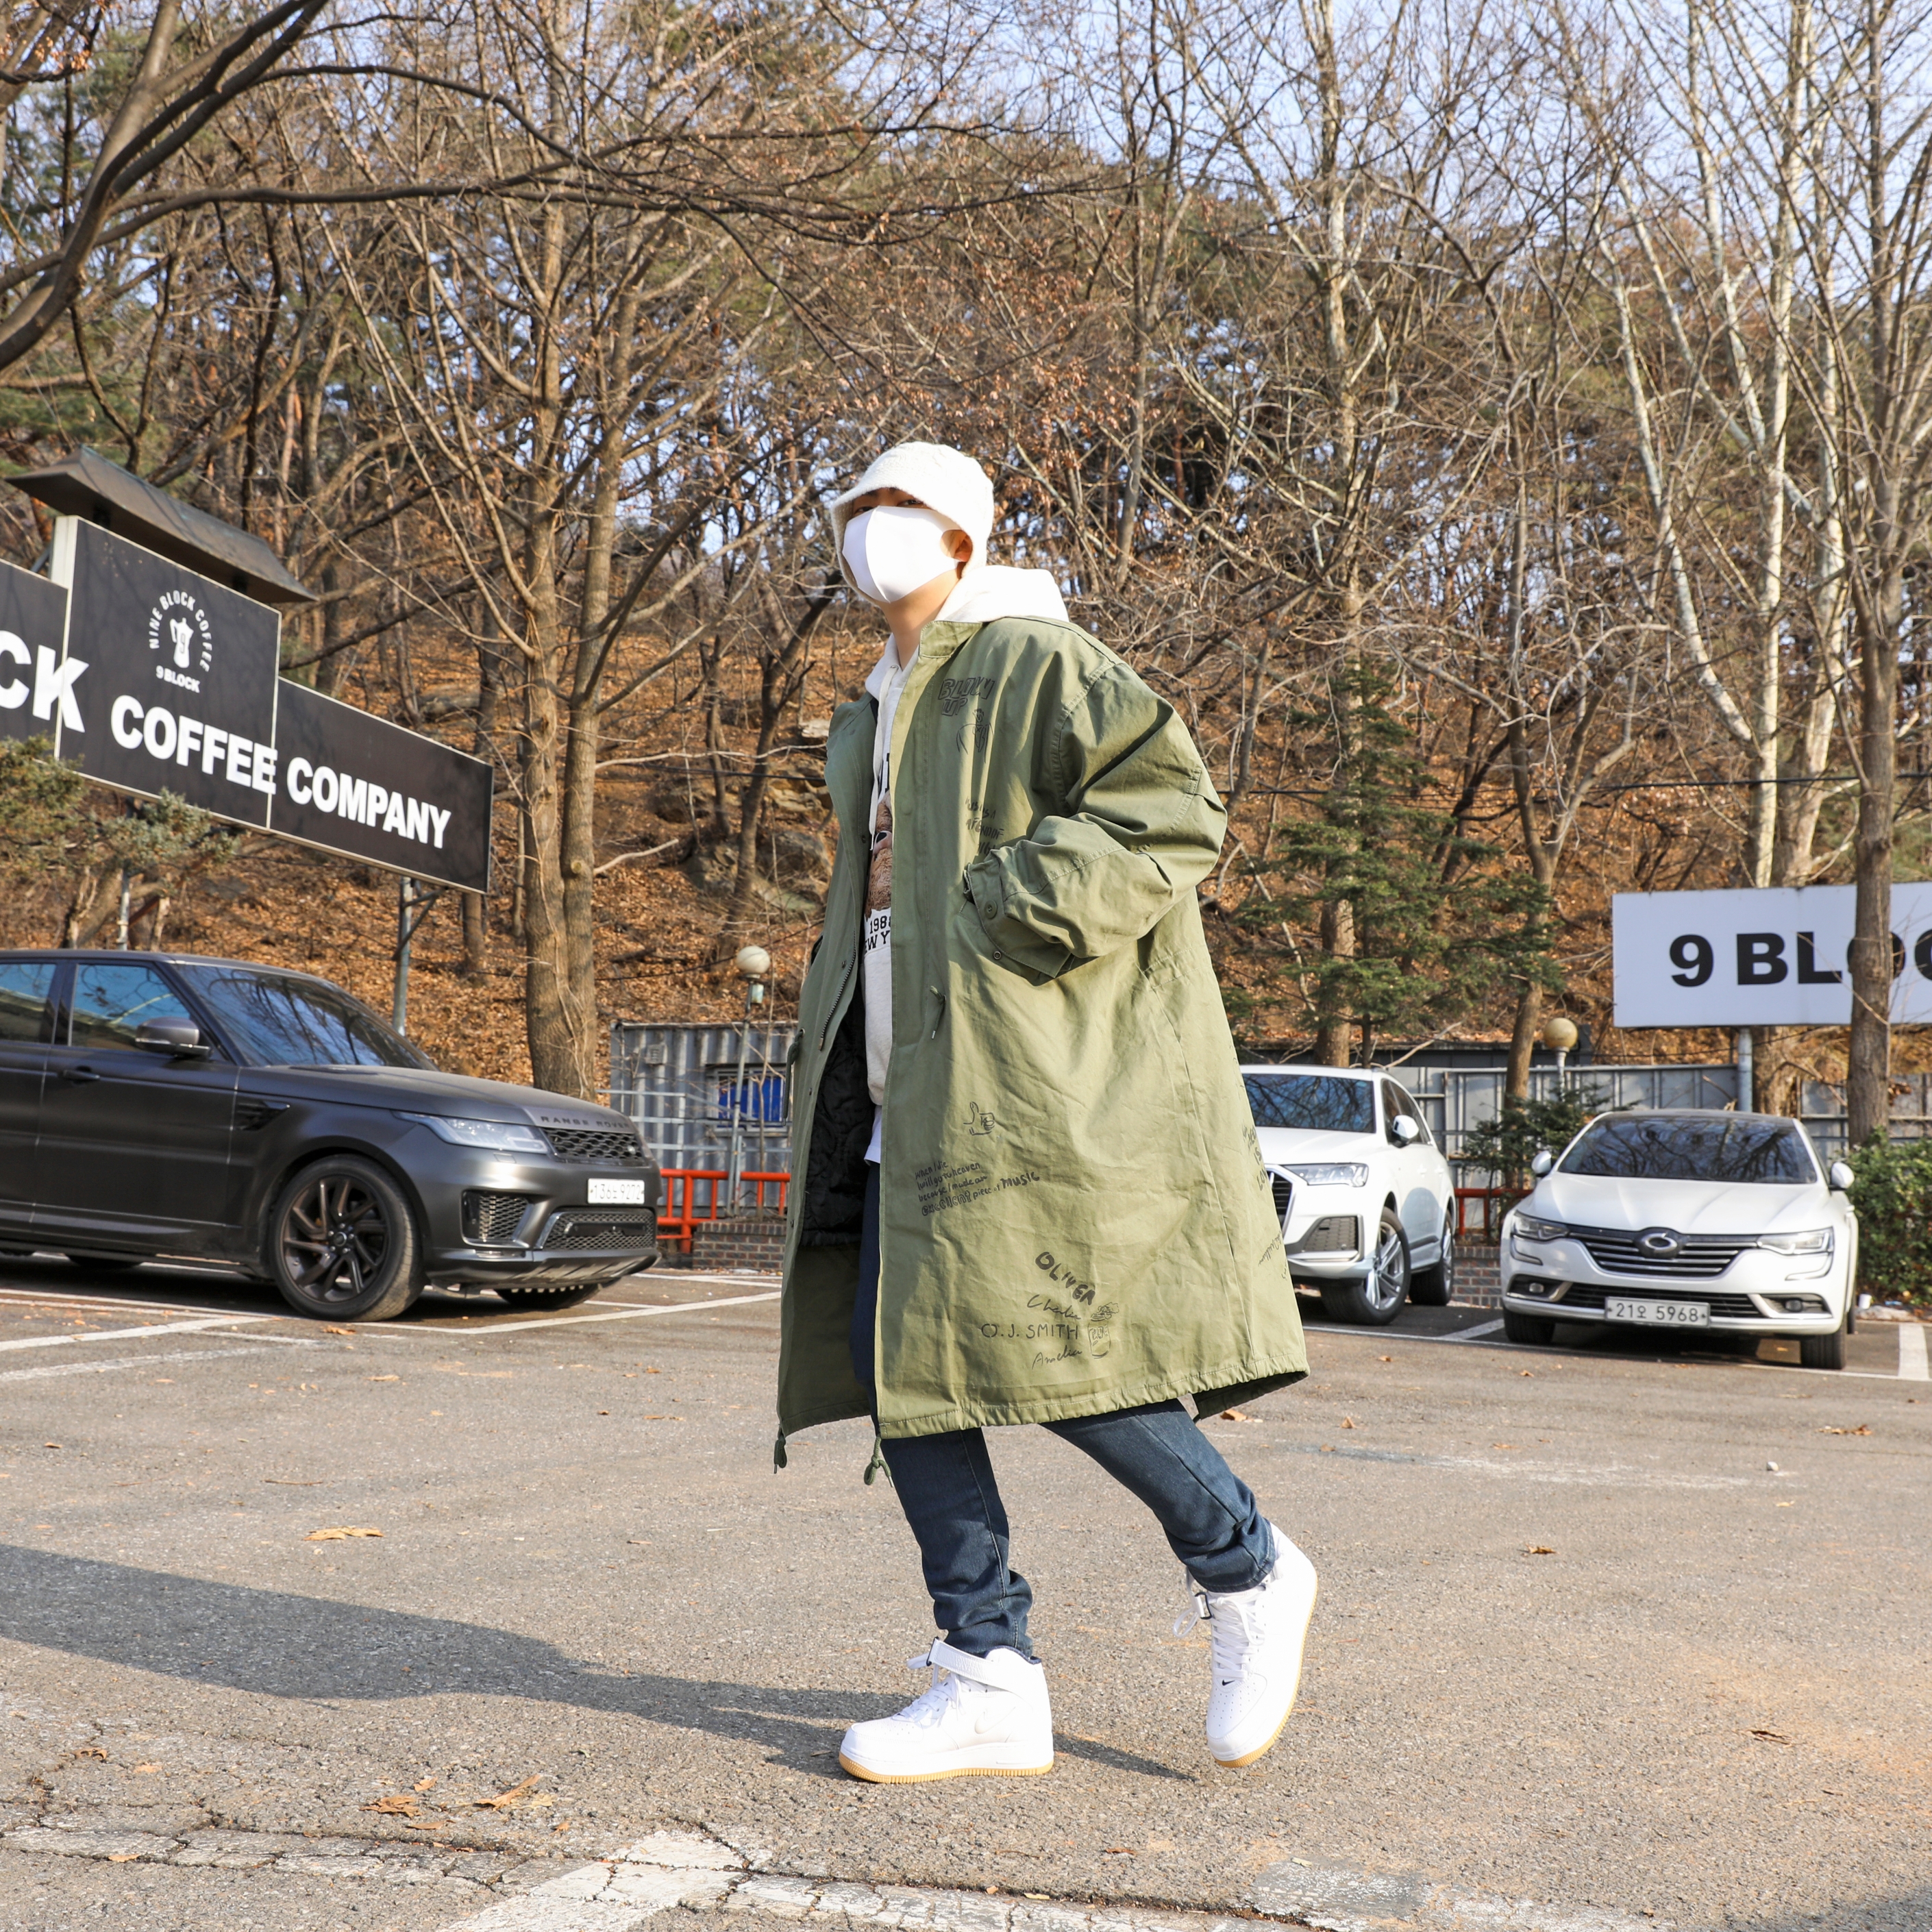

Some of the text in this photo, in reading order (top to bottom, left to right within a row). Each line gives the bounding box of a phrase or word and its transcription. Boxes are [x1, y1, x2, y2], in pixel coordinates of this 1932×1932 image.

[149, 607, 163, 649] NINE
[159, 590, 196, 611] BLOCK
[111, 695, 278, 795] COFFEE
[286, 757, 451, 849] COMPANY
[1669, 929, 1932, 987] 9 BL
[541, 1116, 589, 1126] RANGE
[1026, 1323, 1078, 1340] SMITH
[1656, 1306, 1698, 1322] 5968
